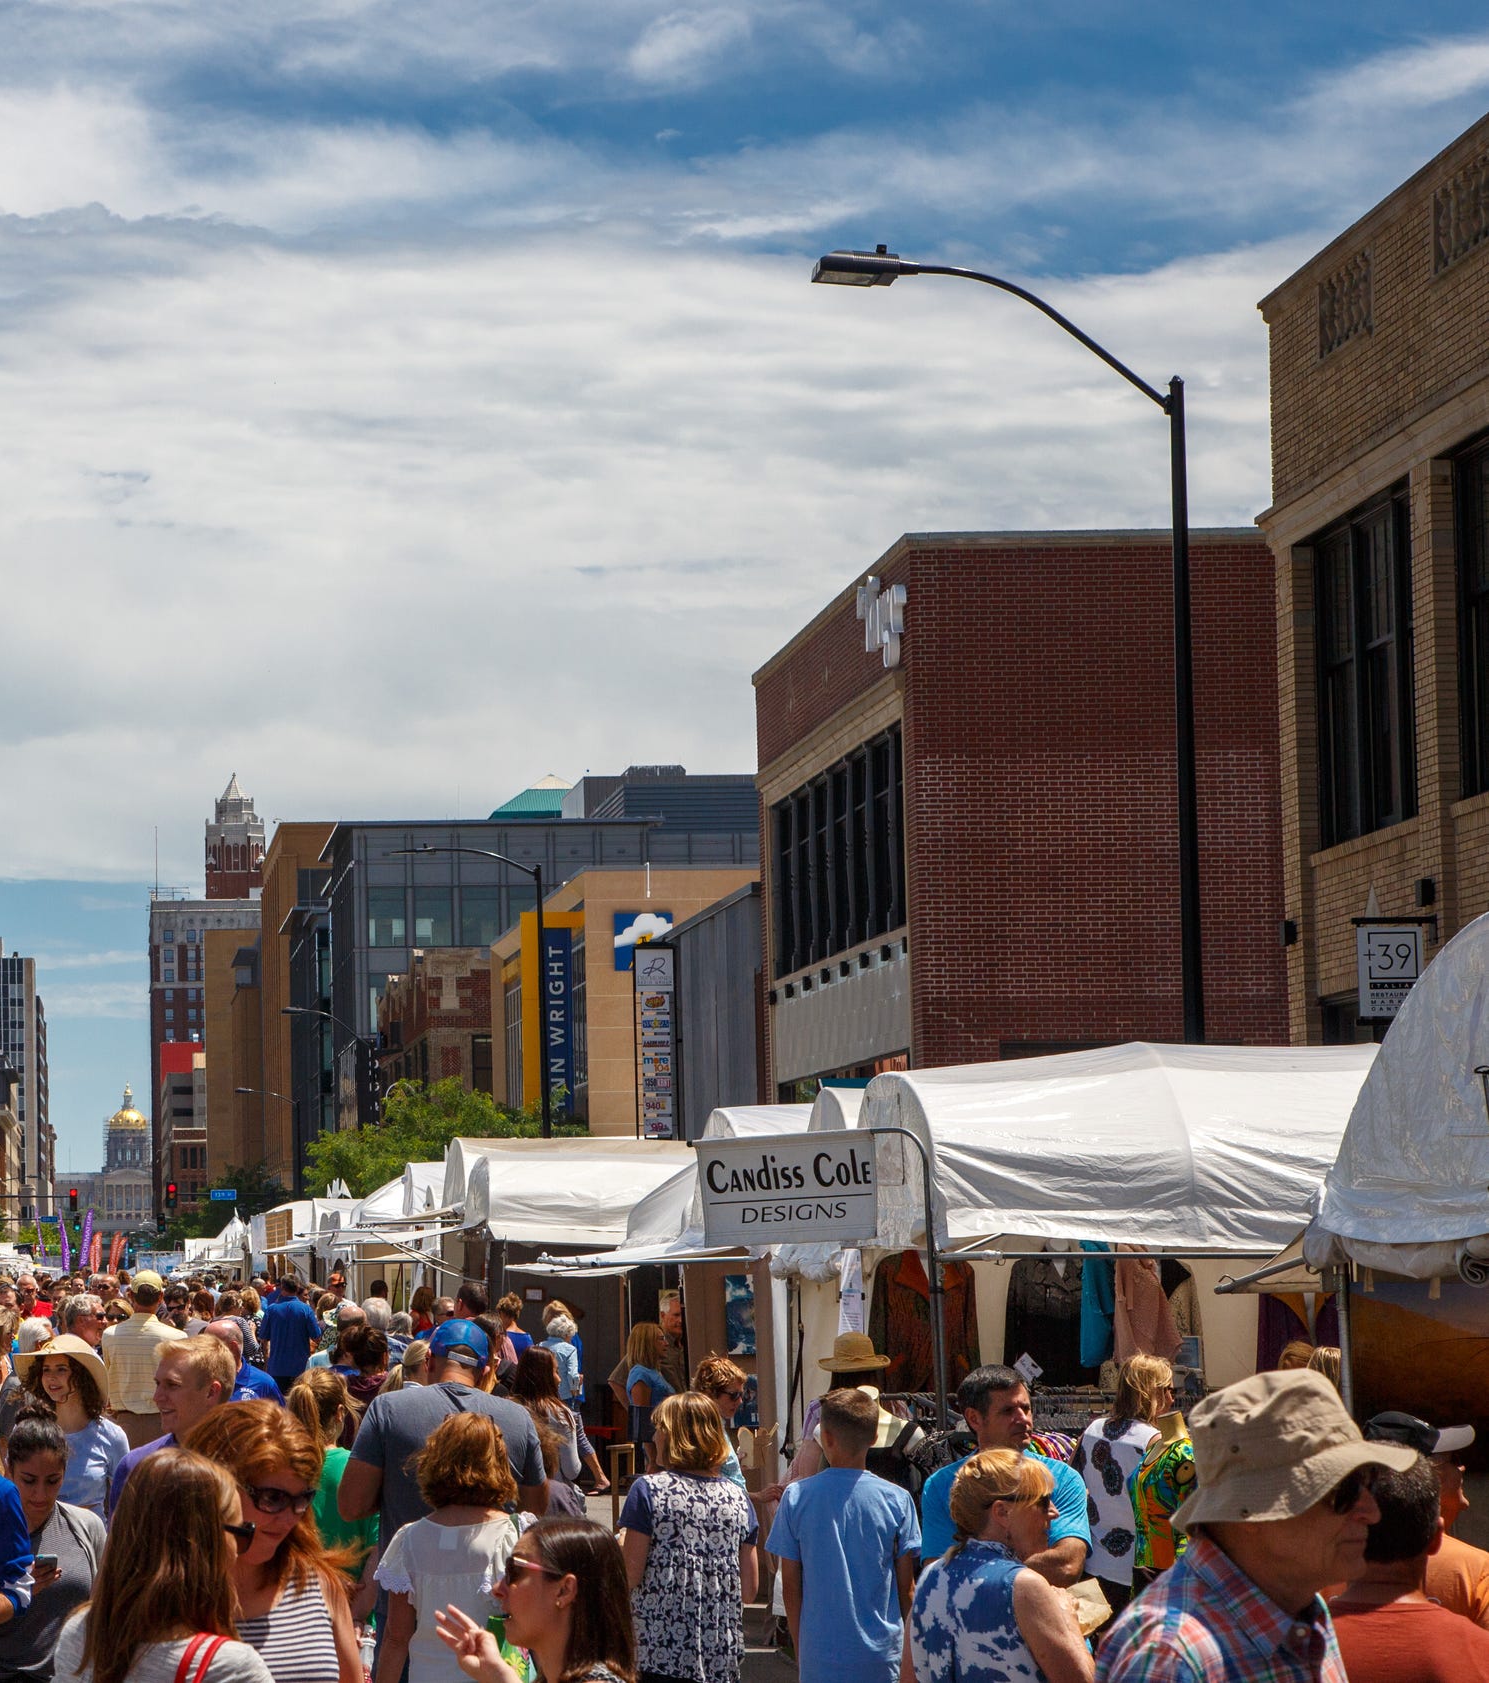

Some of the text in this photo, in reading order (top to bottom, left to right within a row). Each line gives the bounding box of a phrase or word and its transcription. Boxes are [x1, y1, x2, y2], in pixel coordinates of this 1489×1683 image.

[1363, 943, 1412, 970] +39
[548, 946, 565, 1047] WRIGHT
[645, 1102, 661, 1110] 940
[741, 1202, 847, 1224] DESIGNS
